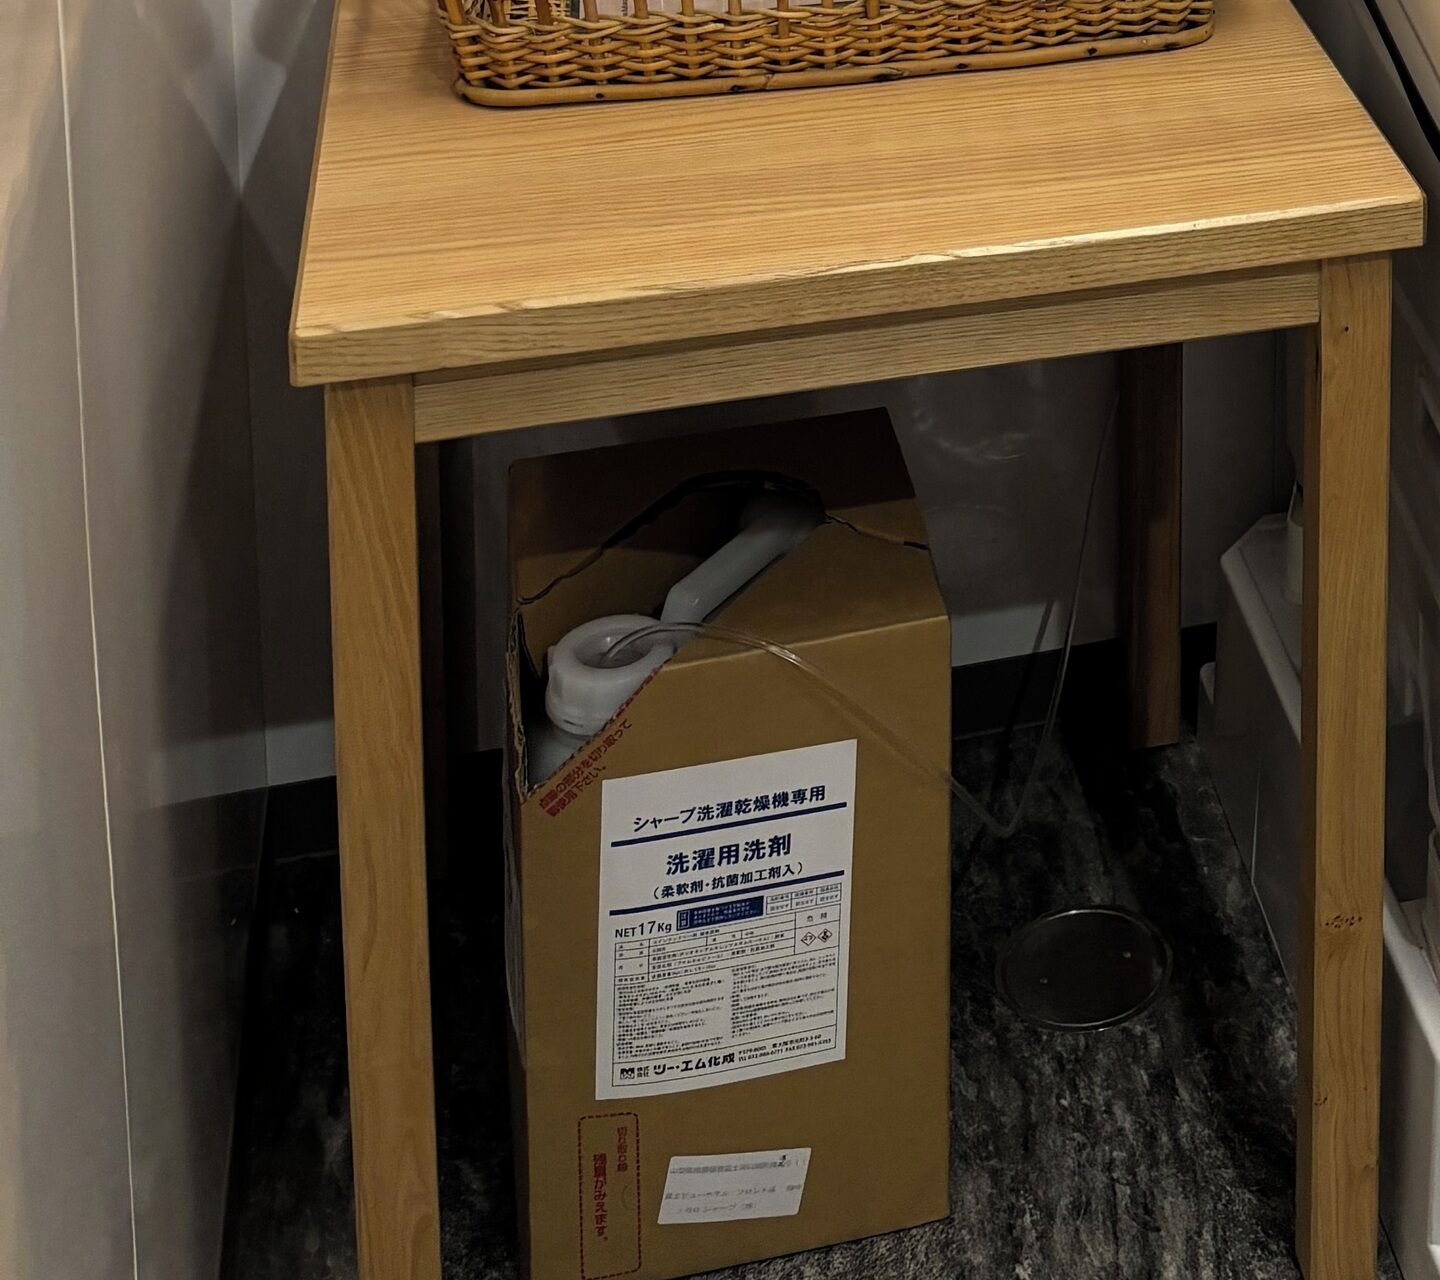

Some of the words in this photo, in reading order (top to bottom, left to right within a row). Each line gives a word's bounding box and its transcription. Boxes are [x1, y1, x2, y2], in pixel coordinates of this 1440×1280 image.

[633, 785, 826, 832] シャープ洗濯乾燥機専用
[666, 833, 792, 876] 洗濯用洗剤
